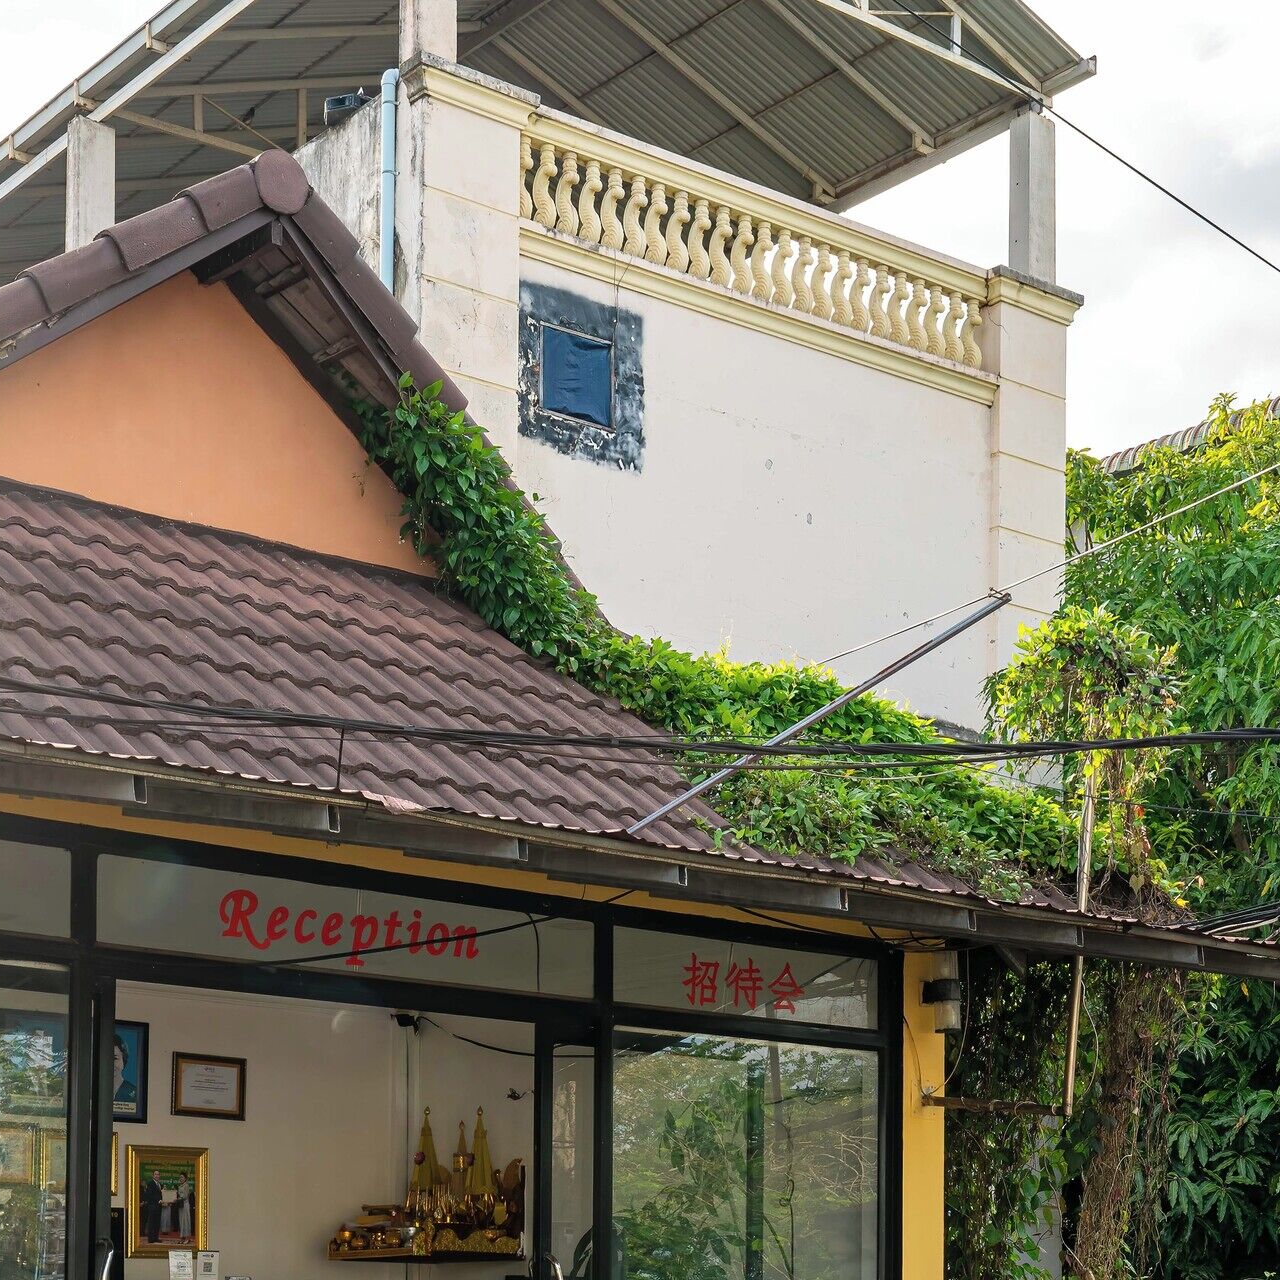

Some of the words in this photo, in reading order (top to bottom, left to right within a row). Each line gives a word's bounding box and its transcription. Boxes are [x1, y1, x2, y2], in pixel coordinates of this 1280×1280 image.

[219, 889, 480, 966] Reception
[682, 952, 805, 1014] 招待会
